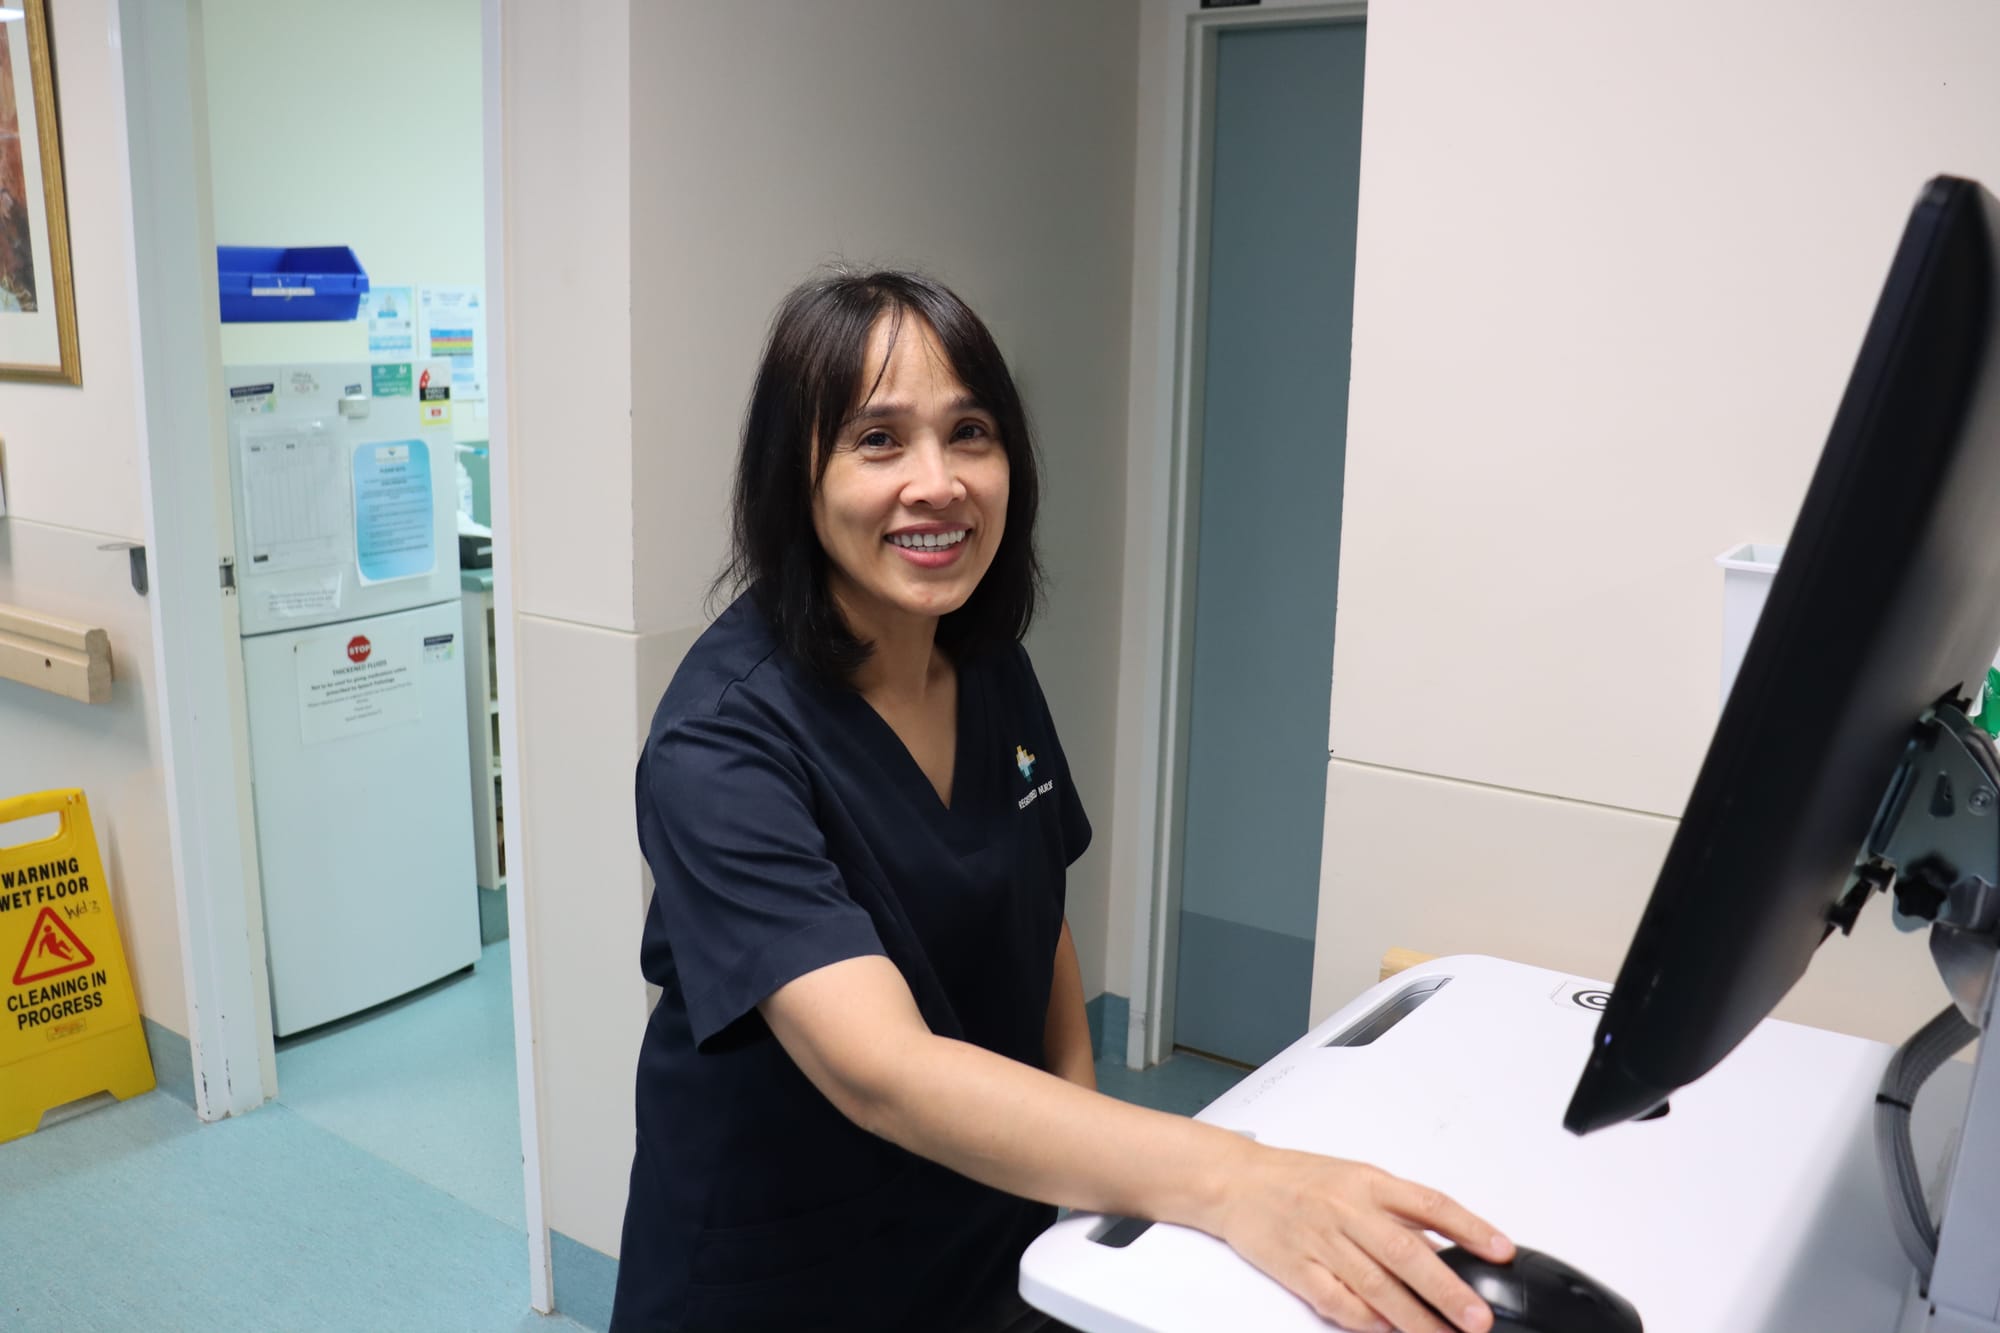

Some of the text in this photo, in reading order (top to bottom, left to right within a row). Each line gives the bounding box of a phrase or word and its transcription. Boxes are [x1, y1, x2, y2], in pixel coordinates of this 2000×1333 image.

[348, 644, 371, 655] STOP
[1, 857, 79, 889] WARNING
[0, 876, 89, 913] WET FLOOR
[7, 969, 107, 1012] CLEANING IN
[17, 991, 103, 1031] PROGRESS
